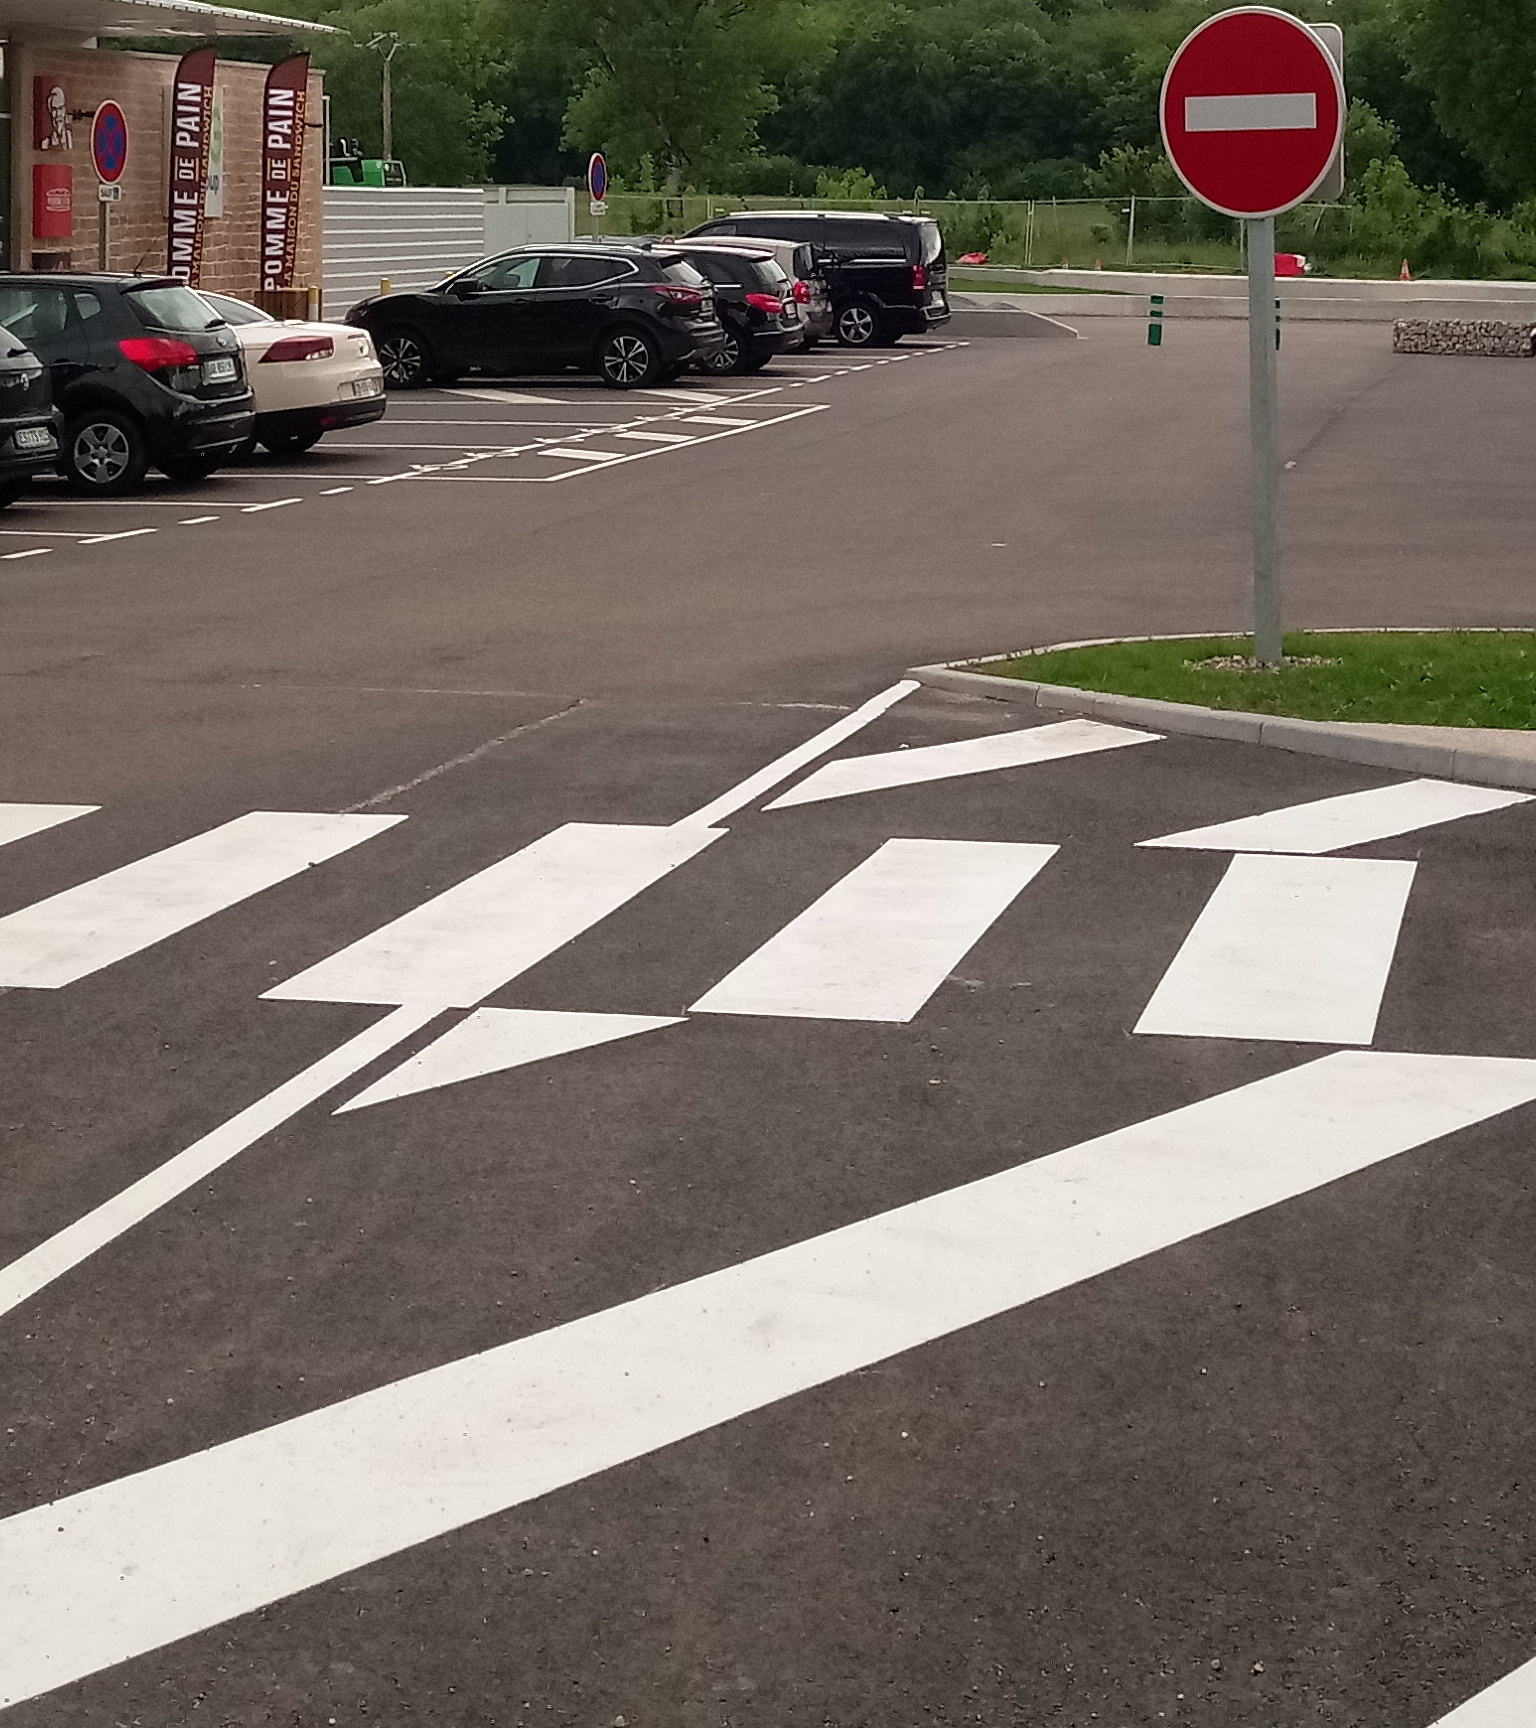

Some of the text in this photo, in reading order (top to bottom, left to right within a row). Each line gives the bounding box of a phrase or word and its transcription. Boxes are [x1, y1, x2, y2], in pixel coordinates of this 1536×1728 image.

[291, 89, 305, 179] SANDWICH
[171, 82, 202, 286] OMME DE PAIN
[264, 88, 294, 291] POMME DE PAIN
[289, 181, 300, 203] DU
[284, 204, 298, 267] MAISON
